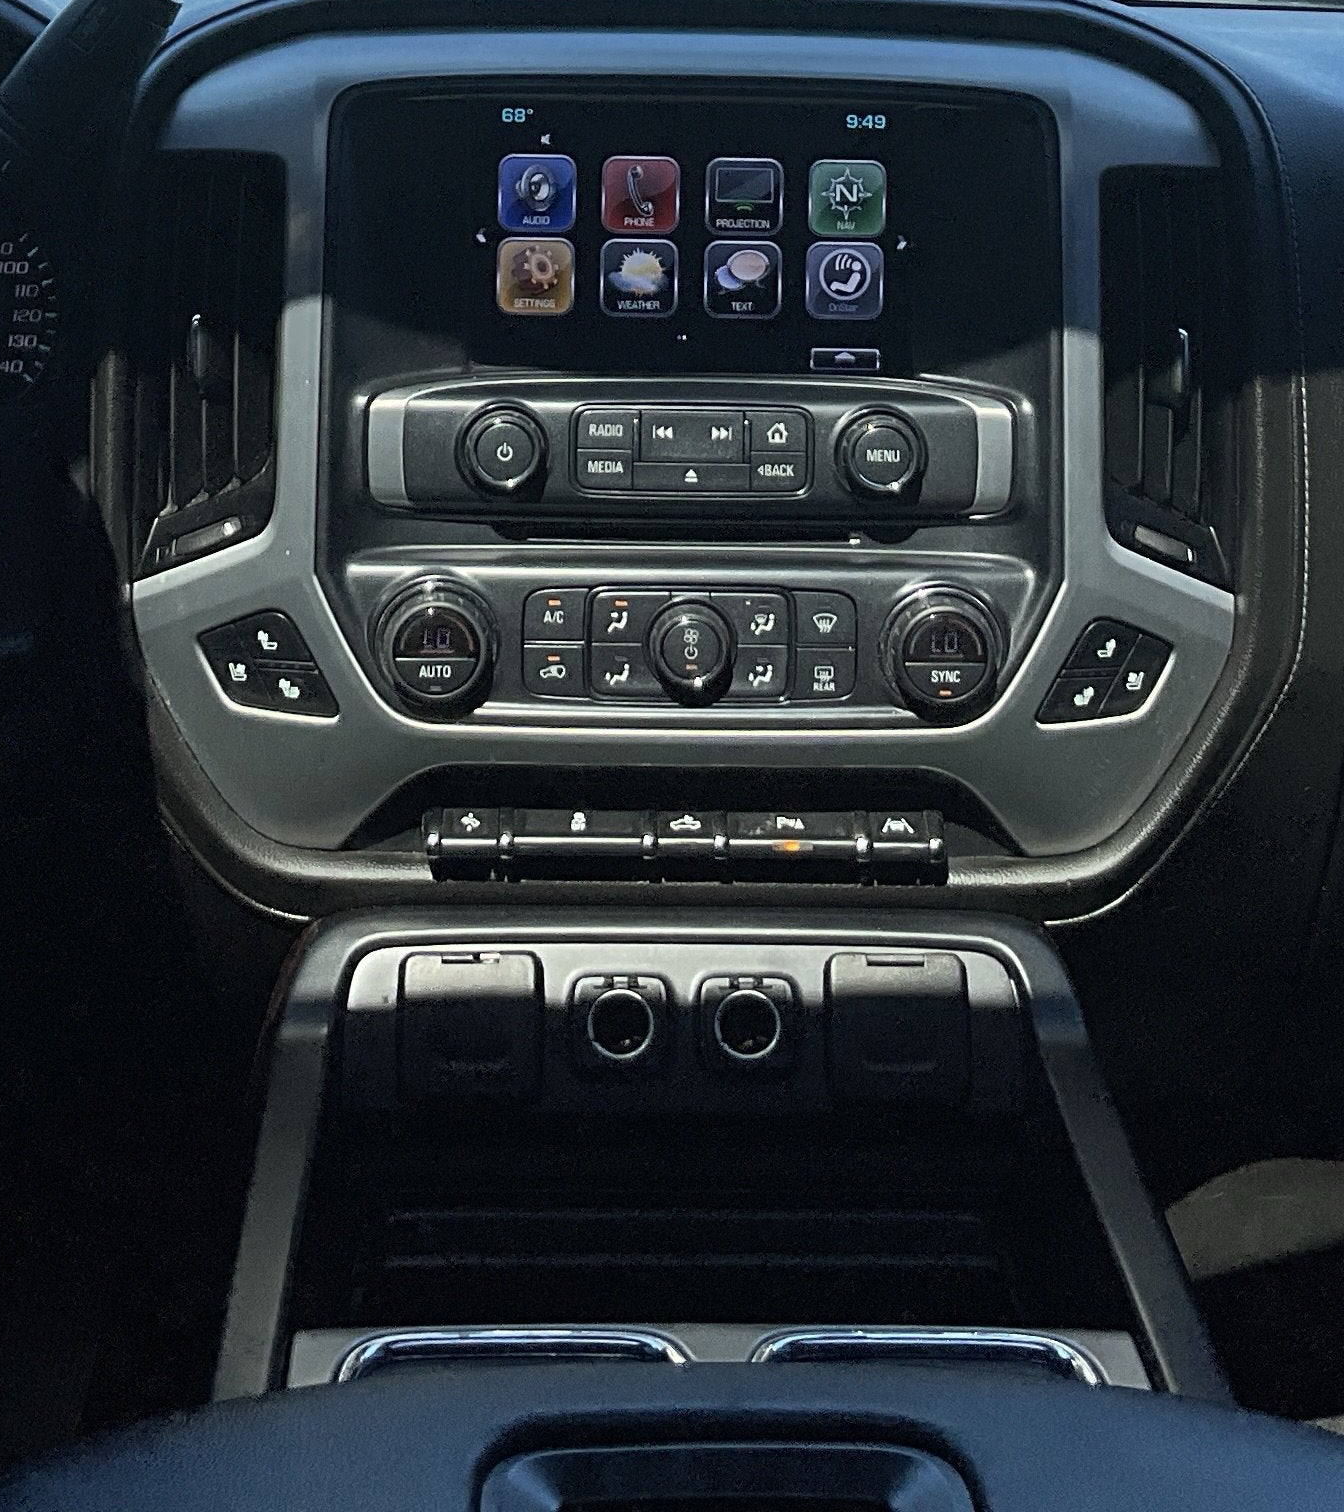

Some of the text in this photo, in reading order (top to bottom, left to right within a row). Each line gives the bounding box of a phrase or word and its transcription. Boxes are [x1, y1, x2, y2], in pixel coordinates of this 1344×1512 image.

[501, 108, 534, 123] 68°
[846, 114, 887, 129] 9:49
[522, 215, 551, 225] AUDIO
[623, 217, 655, 227] PHONE
[715, 218, 771, 229] PROJECTION
[836, 221, 856, 231] NAV
[15, 284, 39, 298] 110
[513, 298, 556, 309] SETTINGS
[617, 299, 661, 311] WEATHER
[731, 301, 754, 312] TEXT
[12, 308, 42, 322] 120
[7, 334, 38, 348] 130
[588, 423, 624, 437] RADIO
[866, 449, 901, 463] MENU
[587, 461, 624, 474] MEDIA
[763, 464, 795, 477] BACK
[543, 610, 565, 625] A/C
[418, 664, 452, 679] AUTO
[930, 669, 961, 684] SYNC
[813, 681, 836, 692] REAR
